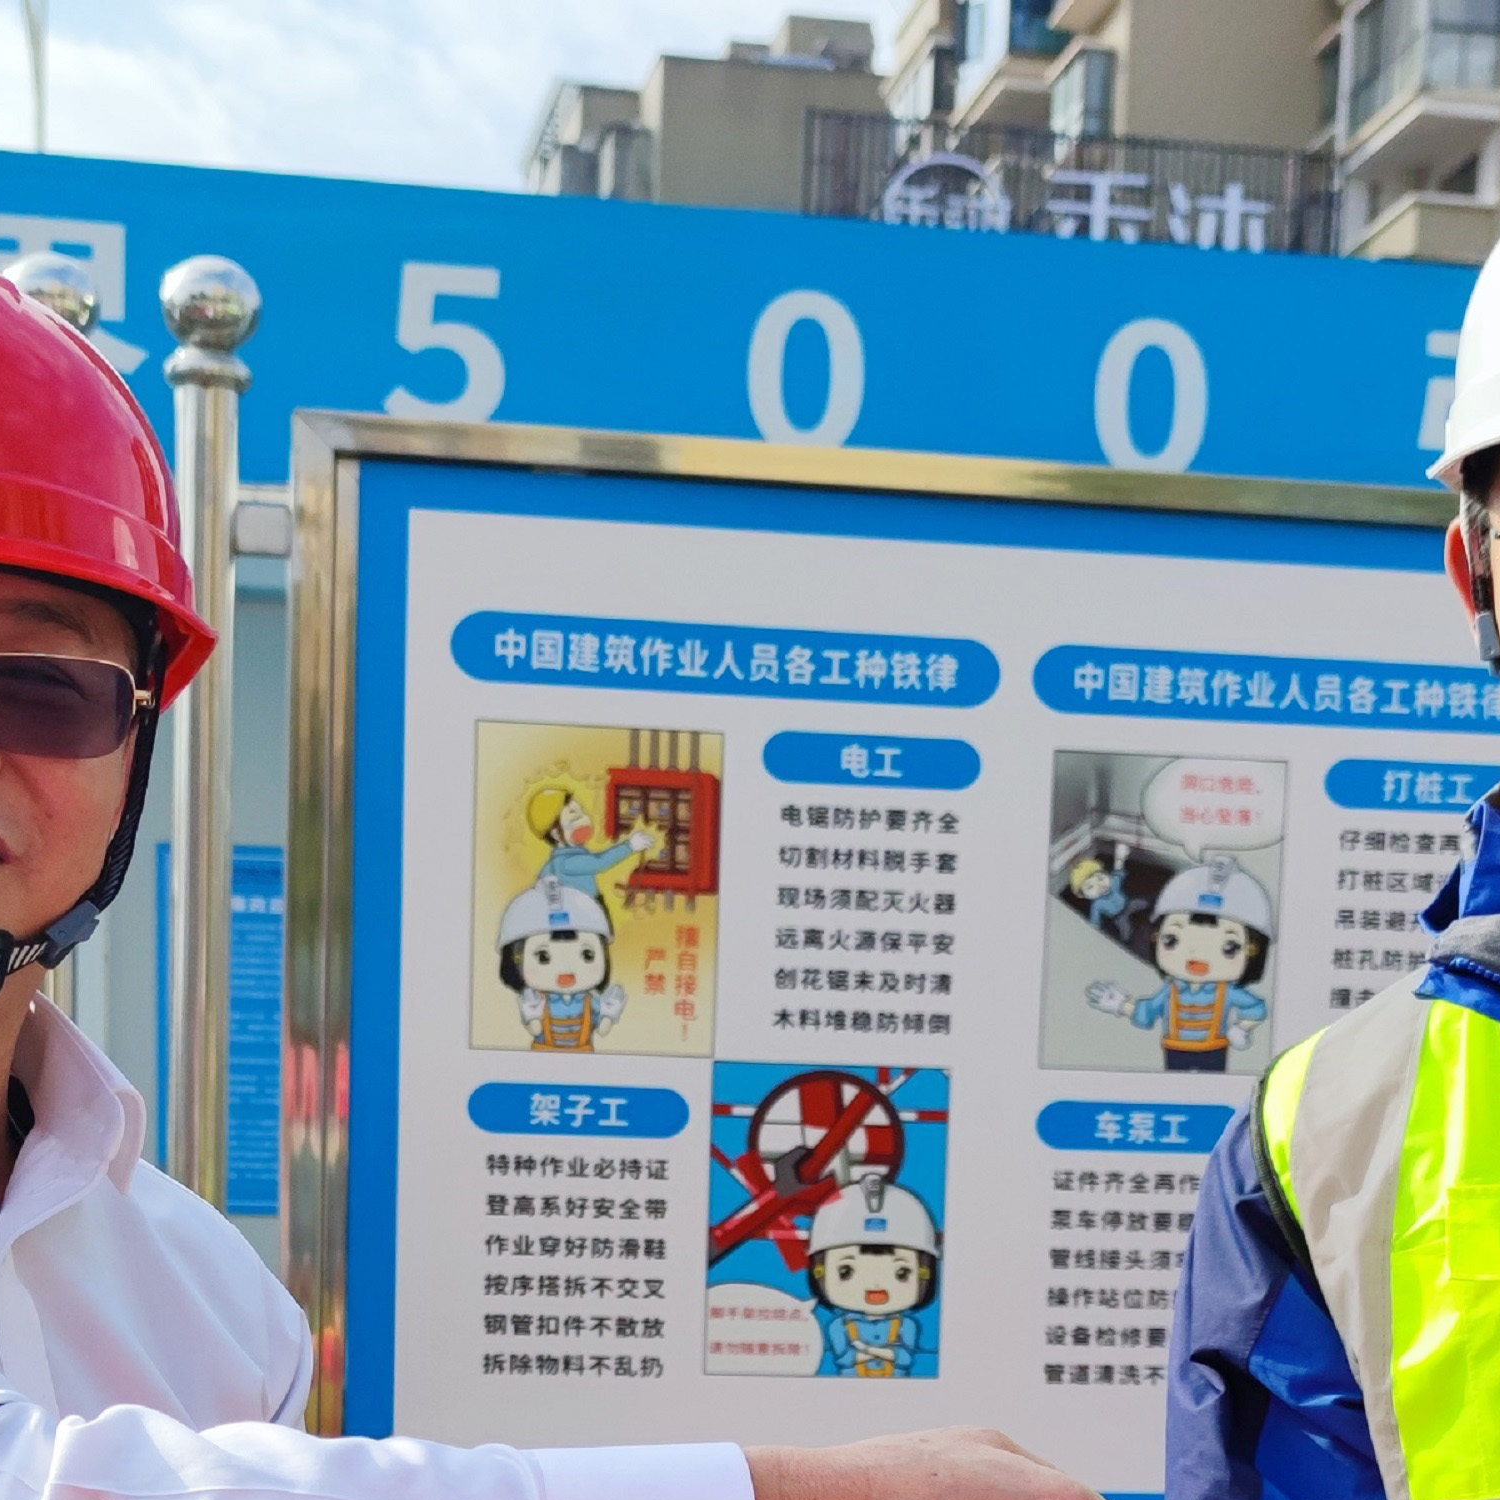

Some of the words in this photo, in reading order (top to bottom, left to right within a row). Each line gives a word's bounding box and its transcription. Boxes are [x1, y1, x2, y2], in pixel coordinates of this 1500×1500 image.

[493, 628, 960, 692] 中国建筑作业人员各工种铁律
[838, 742, 901, 780] 电工
[1383, 770, 1472, 806] 打桩工
[780, 804, 960, 835] 电锯防护要齐全
[778, 845, 958, 875] 切割材料脱手套
[777, 885, 956, 916] 现场须配灭火器
[774, 927, 955, 955] 远离火源保平安
[643, 946, 668, 996] 严禁
[772, 1008, 951, 1036] 木料堆稳防倾倒
[530, 1090, 626, 1129] 架子工
[1096, 1110, 1184, 1145] 车泵工
[485, 1153, 669, 1181] 特种作业必持证
[485, 1193, 668, 1220] 登高系好安全带
[484, 1234, 667, 1260] 作业穿好防滑鞋
[483, 1273, 665, 1299] 按序搭拆不交叉
[1045, 1285, 1177, 1312] 操作站位防
[483, 1313, 665, 1339] 钢管扣件不散放
[1042, 1323, 1168, 1350] 设备检修要
[482, 1352, 664, 1378] 拆除物料不乱扔
[1042, 1362, 1166, 1388] 管道清洗不
